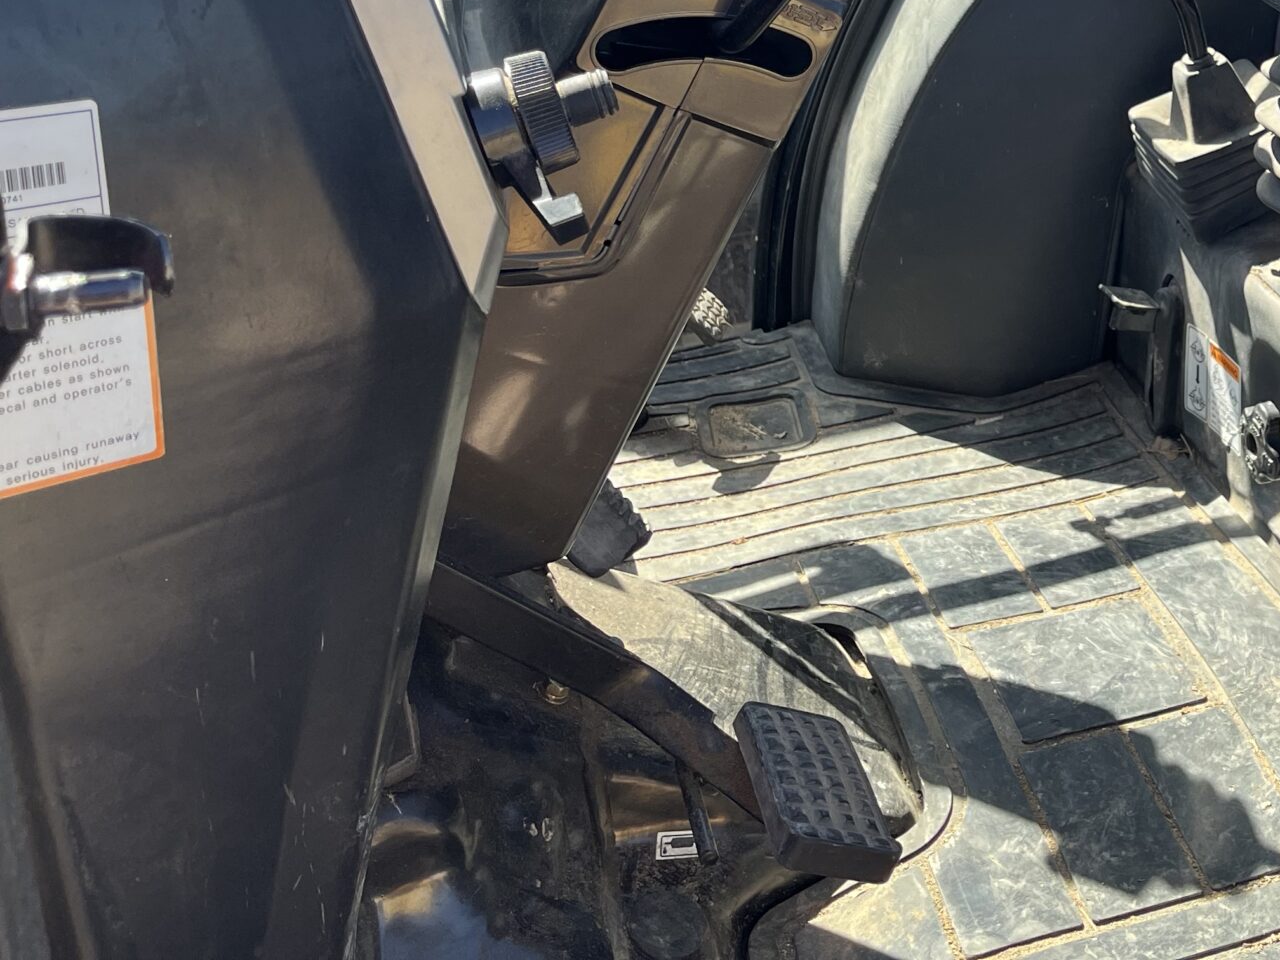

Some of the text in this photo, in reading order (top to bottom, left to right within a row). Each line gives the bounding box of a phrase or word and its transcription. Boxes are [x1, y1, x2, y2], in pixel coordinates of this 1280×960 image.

[38, 345, 73, 360] short
[79, 335, 122, 351] across
[18, 377, 62, 396] cables
[68, 374, 84, 385] as
[89, 363, 130, 381] shown
[43, 353, 104, 375] solenoid.
[32, 393, 57, 408] and
[63, 377, 132, 401] operator's
[26, 445, 79, 466] causing
[85, 431, 140, 451] runaway
[6, 455, 105, 486] serious injury.
